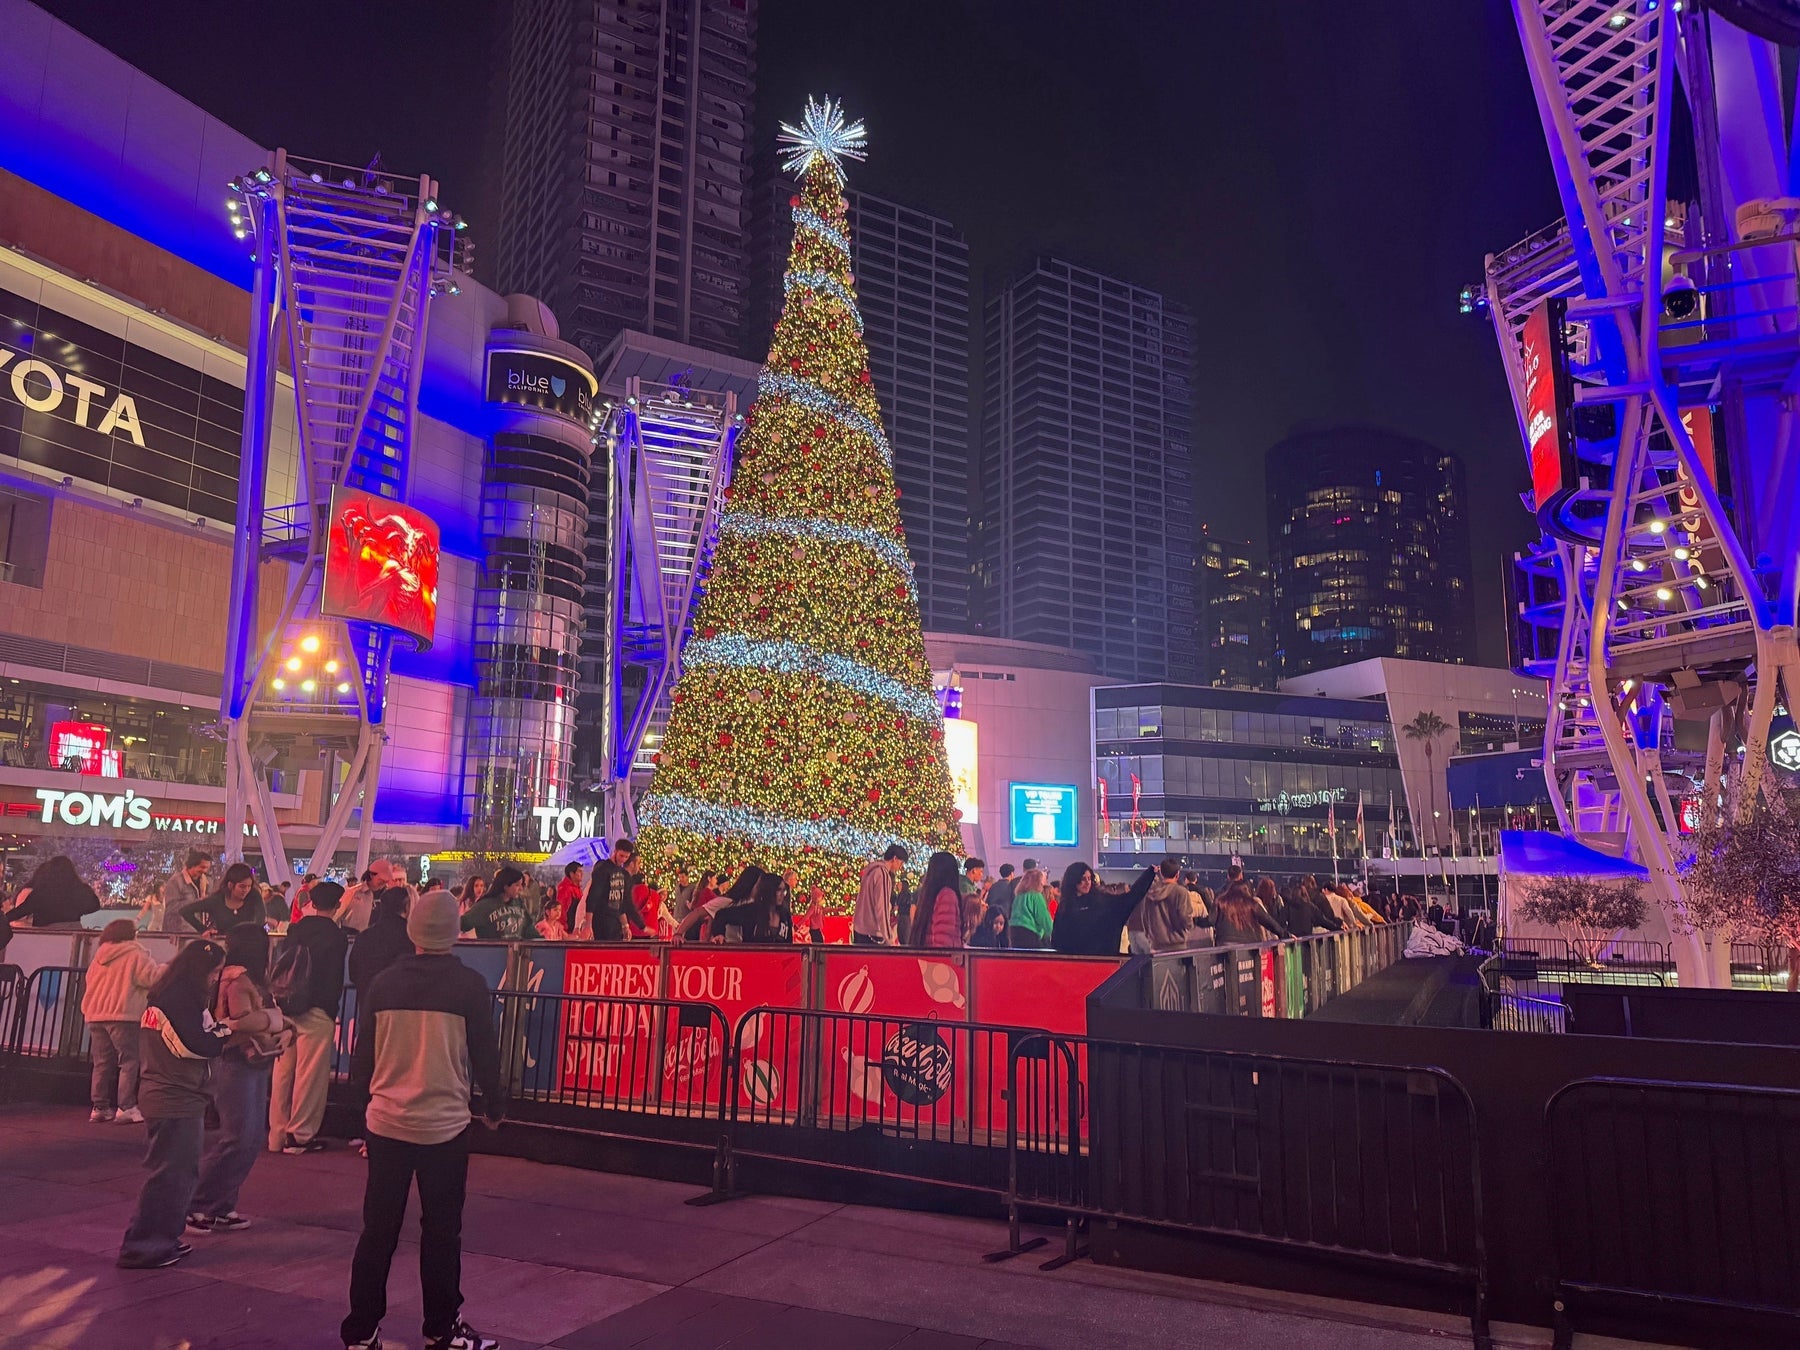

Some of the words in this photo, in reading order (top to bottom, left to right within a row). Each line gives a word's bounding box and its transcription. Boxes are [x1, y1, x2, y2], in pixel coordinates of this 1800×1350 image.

[508, 369, 549, 389] blue
[508, 384, 549, 394] CALIFORNIA
[36, 789, 153, 830] TOM'S
[155, 816, 218, 834] WATCH
[672, 965, 743, 1001] YOUR
[566, 1040, 626, 1077] SPIRIT
